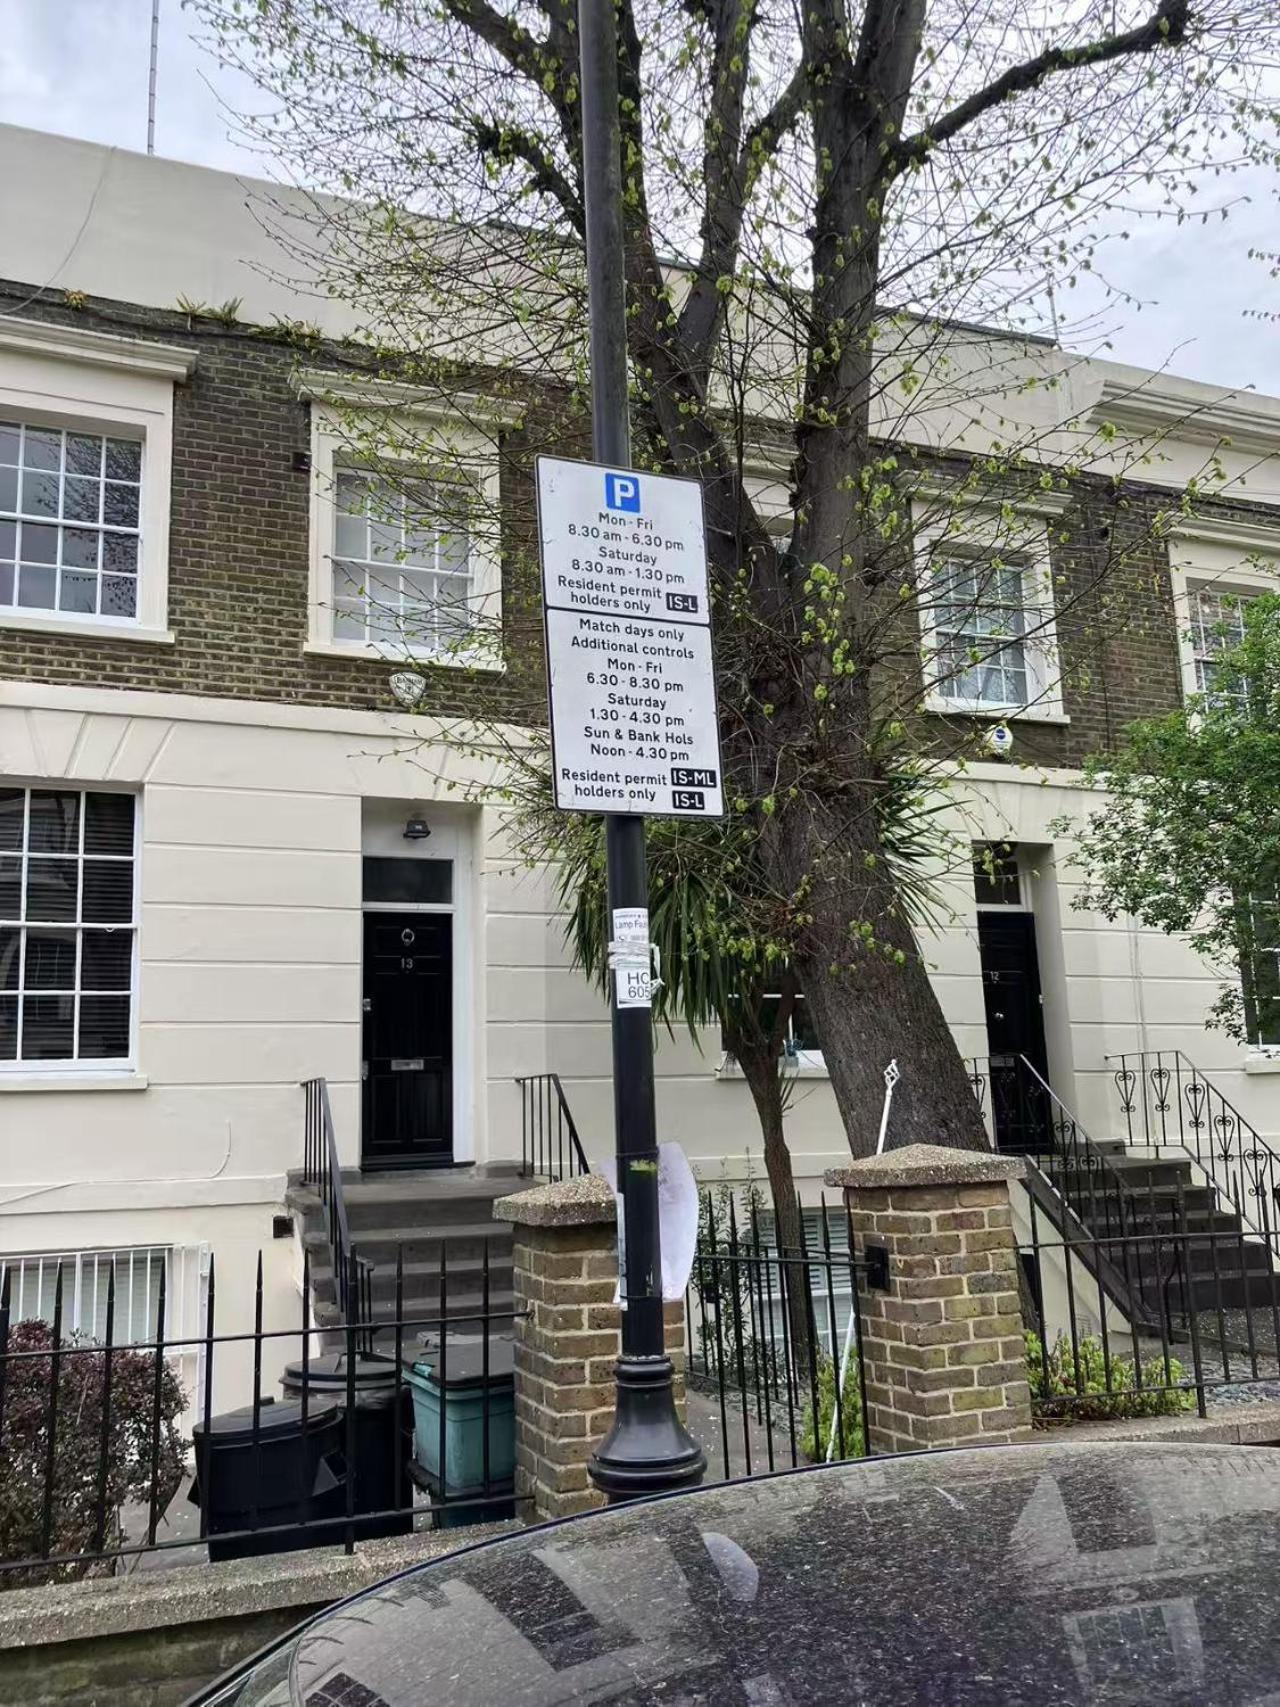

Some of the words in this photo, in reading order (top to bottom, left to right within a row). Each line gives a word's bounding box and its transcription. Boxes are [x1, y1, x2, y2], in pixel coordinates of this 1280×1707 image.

[613, 478, 634, 507] P
[599, 512, 626, 526] Mon
[637, 519, 653, 529] Fri
[568, 524, 599, 538] 8.30
[603, 532, 621, 542] am
[632, 533, 662, 547] 6.30
[665, 540, 684, 551] pm
[599, 547, 657, 566] Saturday
[572, 560, 603, 573] 8.30
[607, 567, 625, 576] am
[636, 568, 662, 581] 1.30
[666, 574, 685, 584] pm
[558, 576, 616, 593] Resident
[621, 585, 662, 598] permit
[571, 592, 619, 608] holders
[624, 600, 650, 613] only
[580, 619, 620, 633] Match
[625, 624, 654, 638] days
[658, 629, 684, 642] only
[571, 636, 638, 654] Additional
[642, 644, 694, 659] controls
[608, 659, 635, 671] Mon
[646, 662, 662, 673] Fri
[587, 673, 618, 686] 6.30
[629, 677, 660, 689] 8.30
[665, 682, 684, 692] pm
[608, 693, 666, 710] Saturday
[590, 708, 618, 721] 1.30
[629, 711, 661, 724] 4.30
[665, 716, 684, 726] pm
[584, 726, 610, 739] Sun
[615, 729, 623, 740] &
[628, 730, 660, 743] Bank
[665, 733, 694, 744] Hols
[591, 744, 626, 757] Noon
[636, 747, 667, 759] 4.30
[671, 751, 689, 761] pm
[562, 768, 620, 783] Resident
[625, 774, 667, 785] permit
[673, 770, 714, 786] IS-ML
[575, 785, 624, 798] holders
[629, 789, 656, 801] only
[675, 793, 703, 807] IS-L
[401, 958, 413, 969] 13
